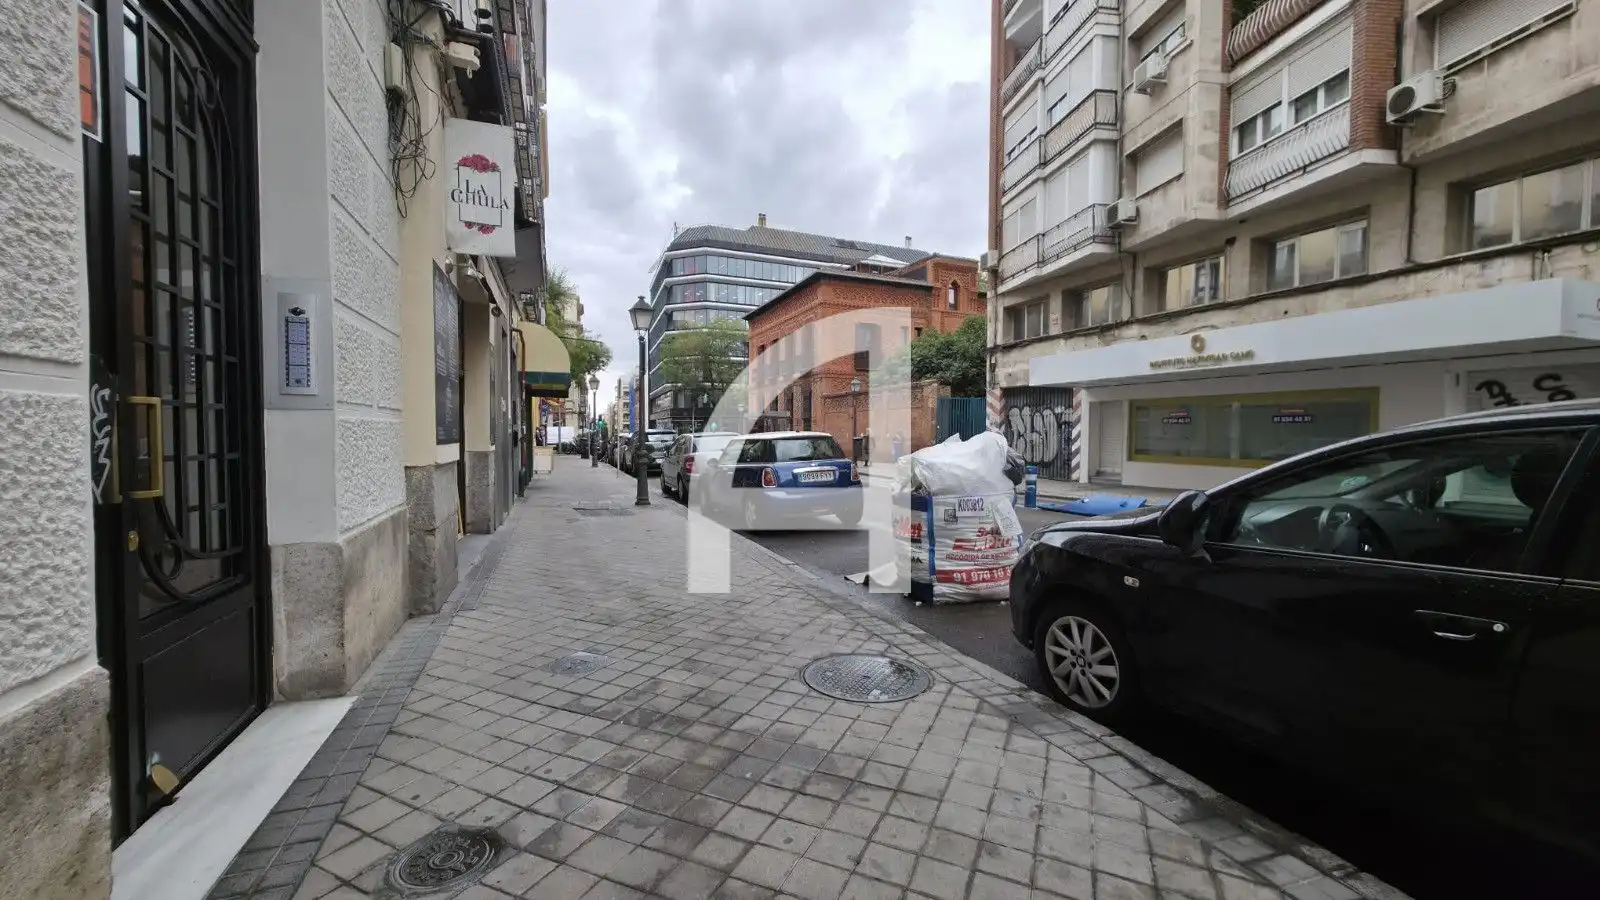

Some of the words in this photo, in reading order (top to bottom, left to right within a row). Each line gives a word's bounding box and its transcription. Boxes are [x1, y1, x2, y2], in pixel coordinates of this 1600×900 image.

[465, 180, 487, 195] LA
[451, 188, 510, 210] CHULA
[953, 571, 967, 583] 91
